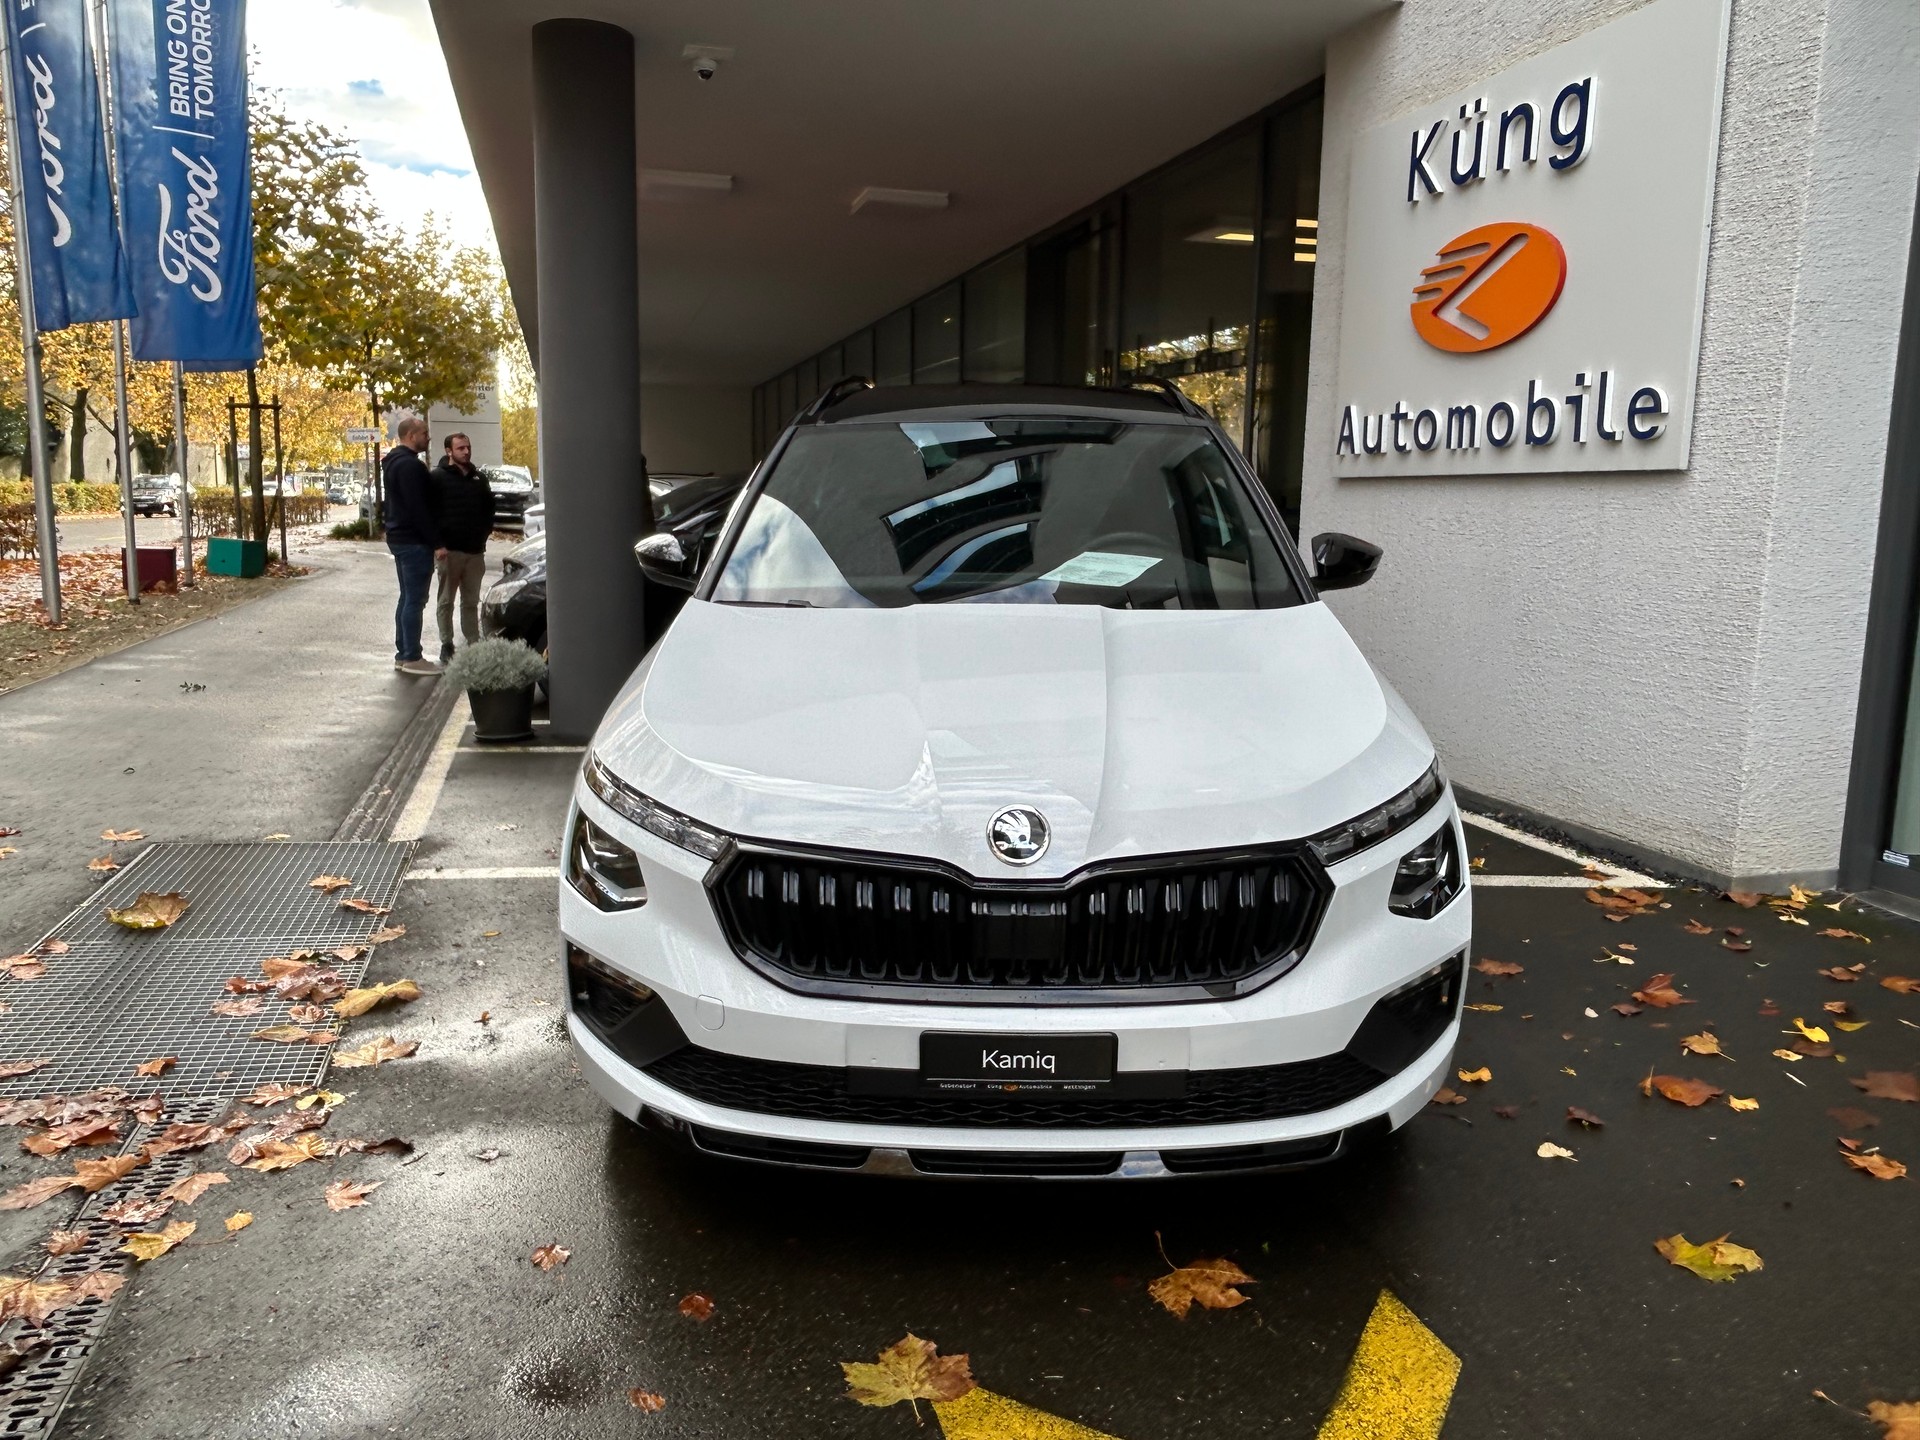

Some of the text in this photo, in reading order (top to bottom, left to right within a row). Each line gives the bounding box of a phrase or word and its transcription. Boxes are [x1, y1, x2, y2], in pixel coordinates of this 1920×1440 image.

[166, 0, 191, 117] BRING ON
[1407, 76, 1599, 203] Küng
[158, 146, 223, 303] Ford
[1336, 370, 1670, 457] Automobile
[982, 1049, 1056, 1074] Kamiq
